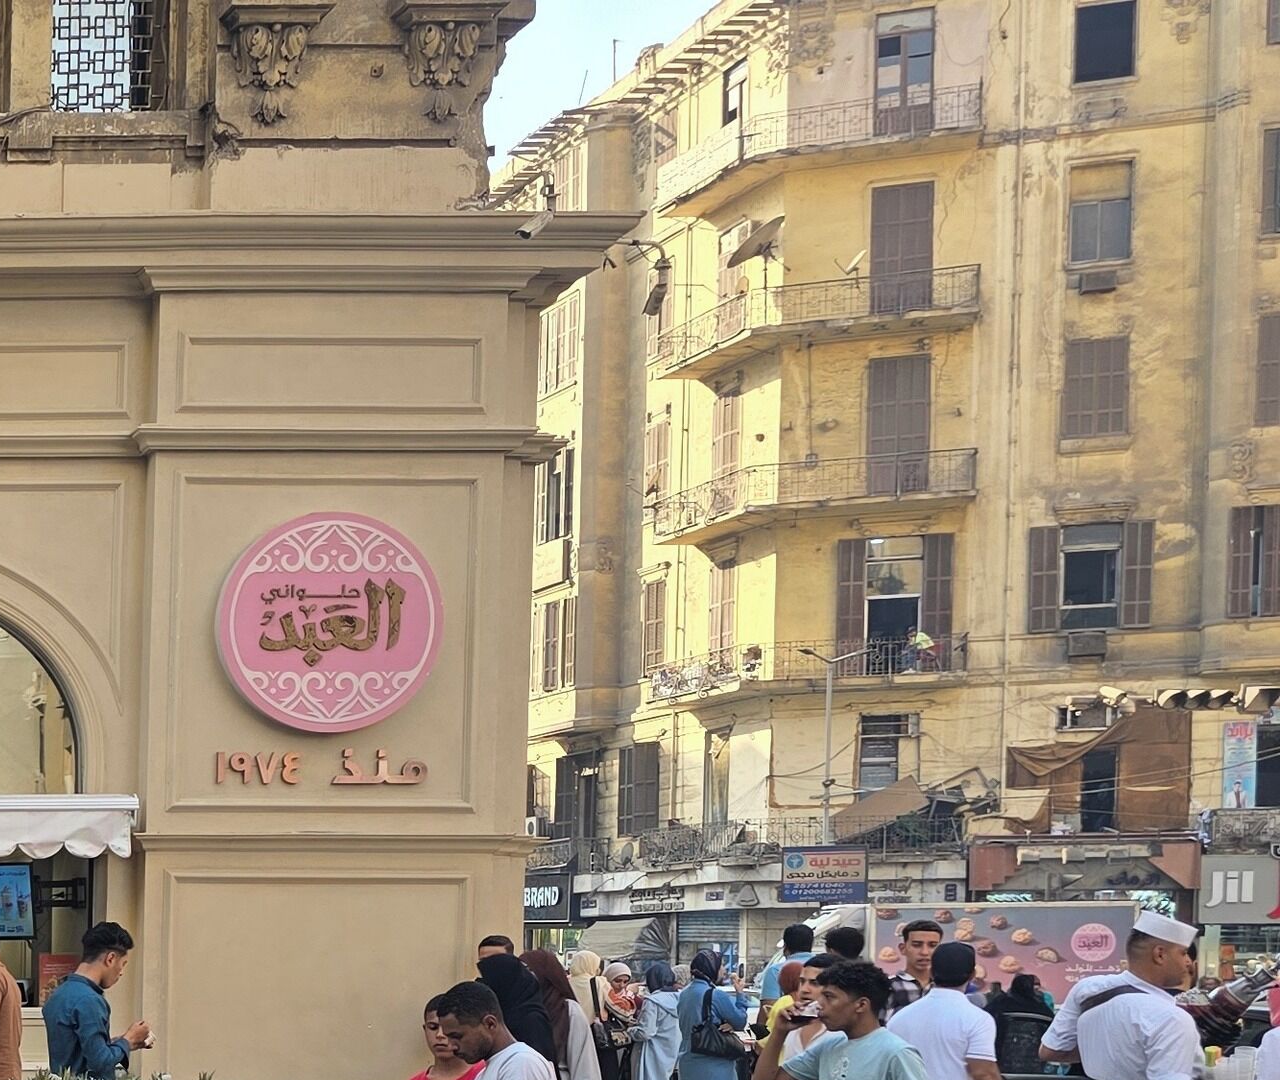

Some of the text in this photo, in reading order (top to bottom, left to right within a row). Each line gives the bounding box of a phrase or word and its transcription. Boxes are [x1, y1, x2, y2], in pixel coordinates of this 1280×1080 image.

[260, 583, 362, 606] حلواني
[258, 578, 407, 668] العبد
[214, 748, 429, 786] منذ ١٩٧٤
[524, 886, 559, 908] BRAND
[1205, 871, 1254, 907] Jil
